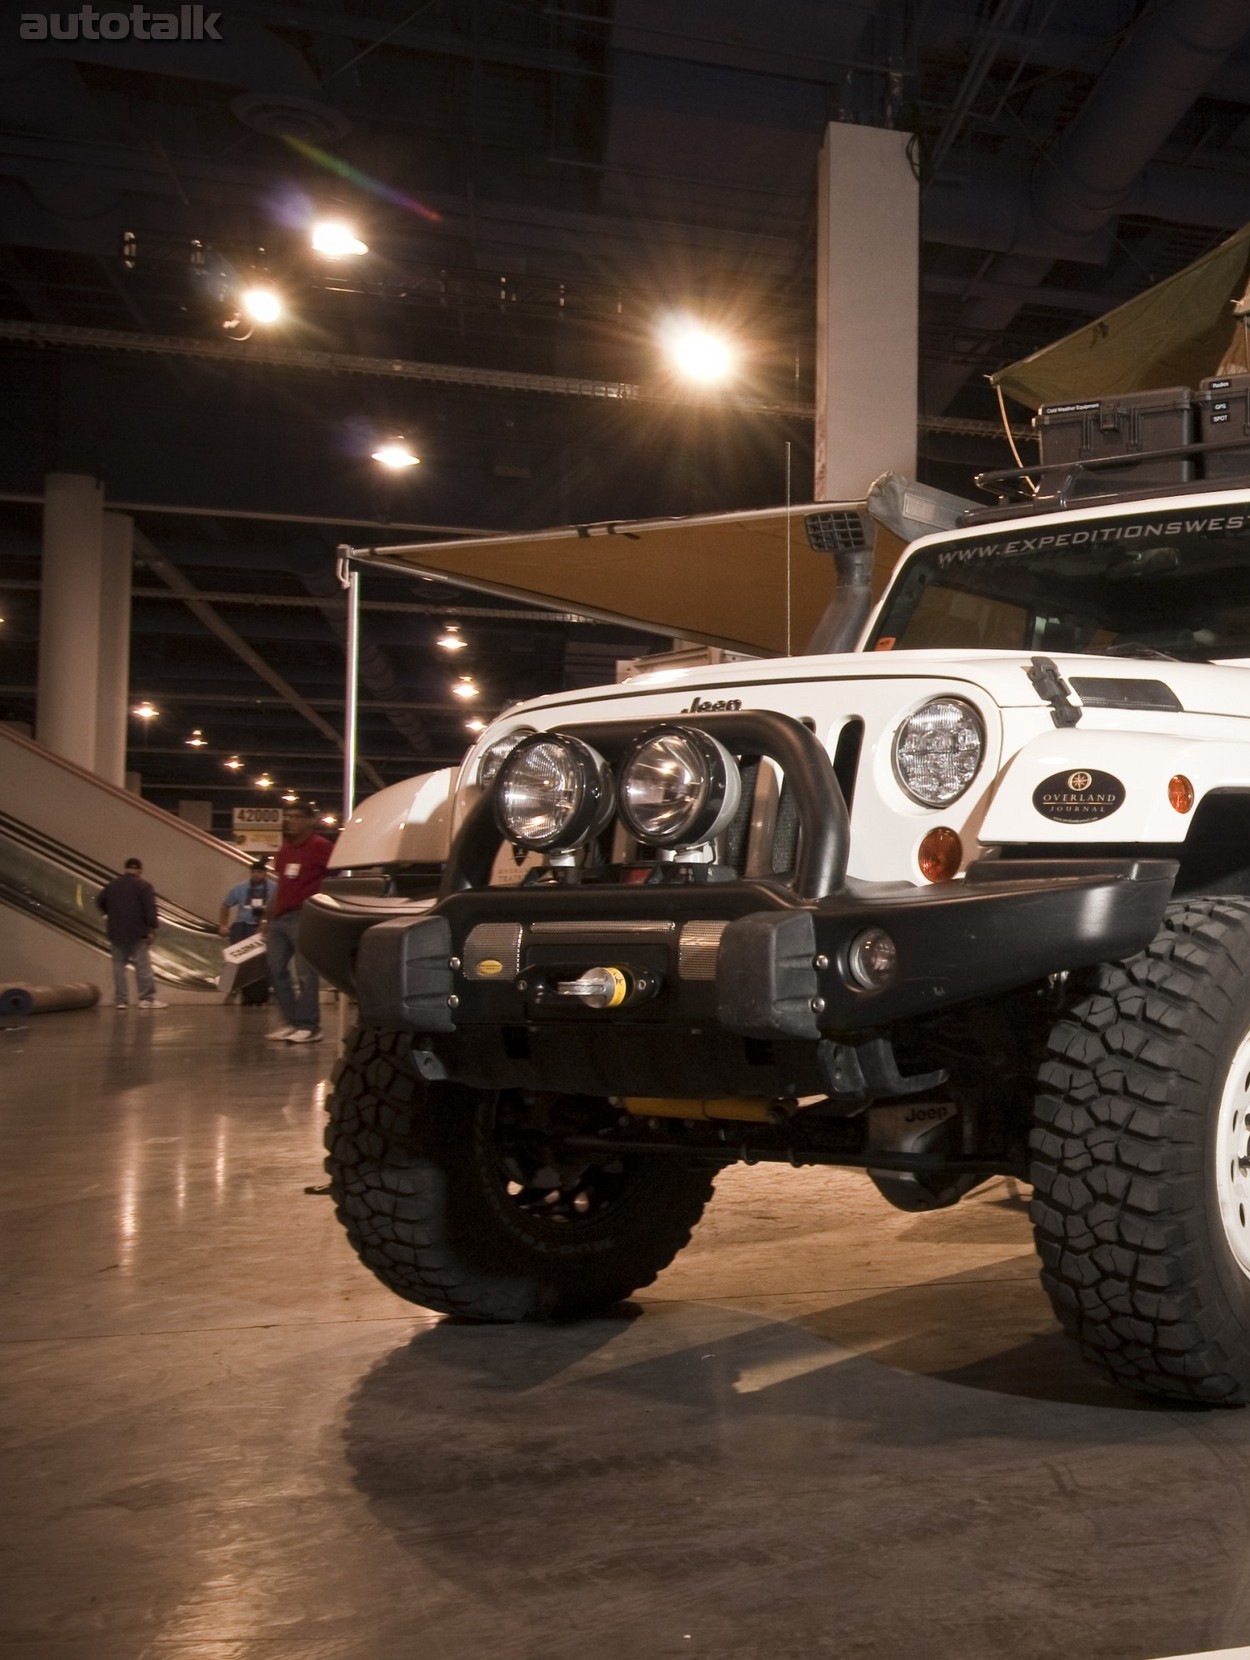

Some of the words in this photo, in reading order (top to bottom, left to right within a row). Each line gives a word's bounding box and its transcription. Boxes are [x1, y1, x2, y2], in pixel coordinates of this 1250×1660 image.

[1043, 794, 1116, 802] OVERLAND
[237, 809, 279, 822] 42000
[905, 1107, 948, 1122] Jeep
